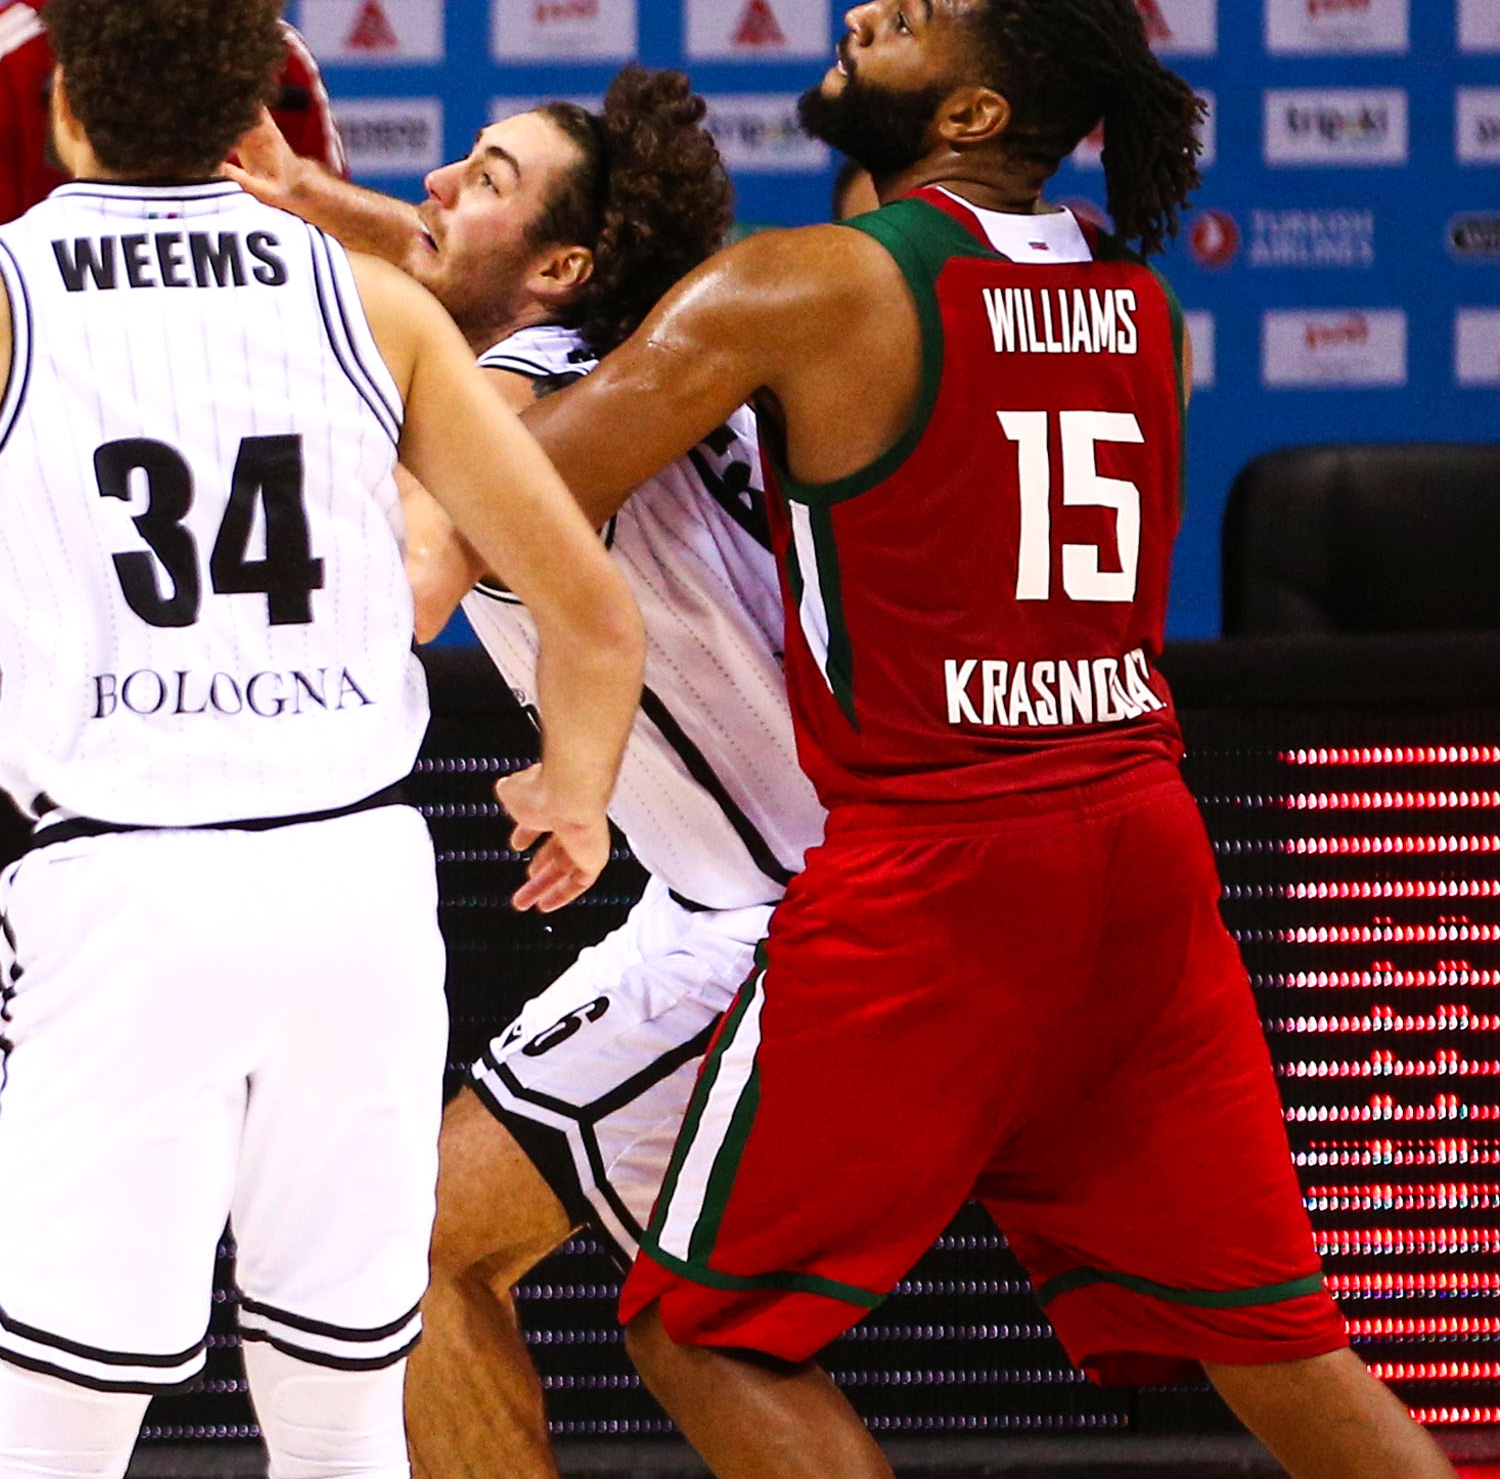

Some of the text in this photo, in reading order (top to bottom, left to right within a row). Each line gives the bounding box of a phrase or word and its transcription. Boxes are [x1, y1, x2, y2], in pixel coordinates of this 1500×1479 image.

[51, 230, 289, 292] WEEMS
[981, 288, 1138, 355] WILLIAMS
[93, 433, 324, 628] 34
[996, 410, 1145, 602] 15
[90, 665, 377, 720] BOLOGNA
[521, 995, 610, 1057] 6
